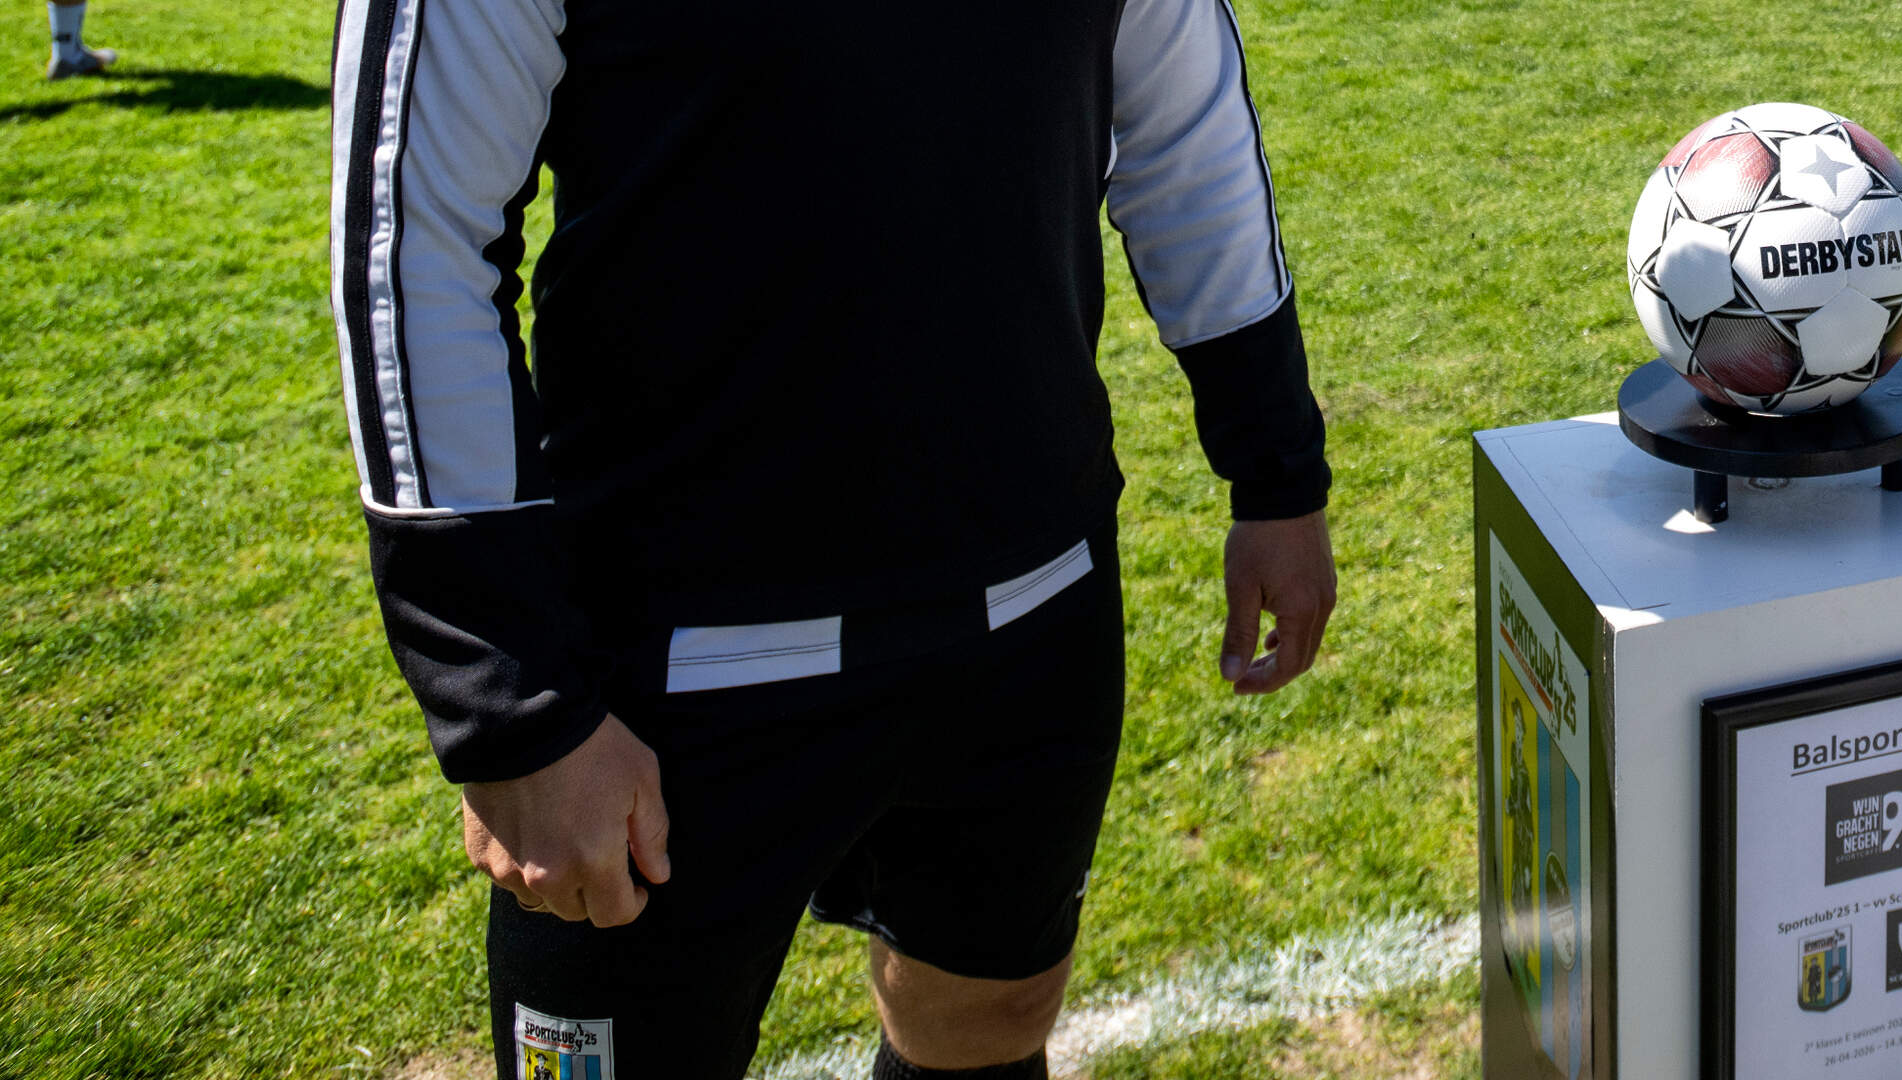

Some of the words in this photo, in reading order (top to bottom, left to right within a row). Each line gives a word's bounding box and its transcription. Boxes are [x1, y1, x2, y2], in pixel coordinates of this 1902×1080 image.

[1499, 580, 1553, 696] SPORTCLUB
[1853, 796, 1880, 817] WIJN
[1836, 813, 1879, 839] GRACHT
[1843, 830, 1880, 854] NEGEN
[1853, 902, 1861, 914] 1
[1873, 897, 1888, 909] vv
[525, 1021, 575, 1045] SPORTCLUB
